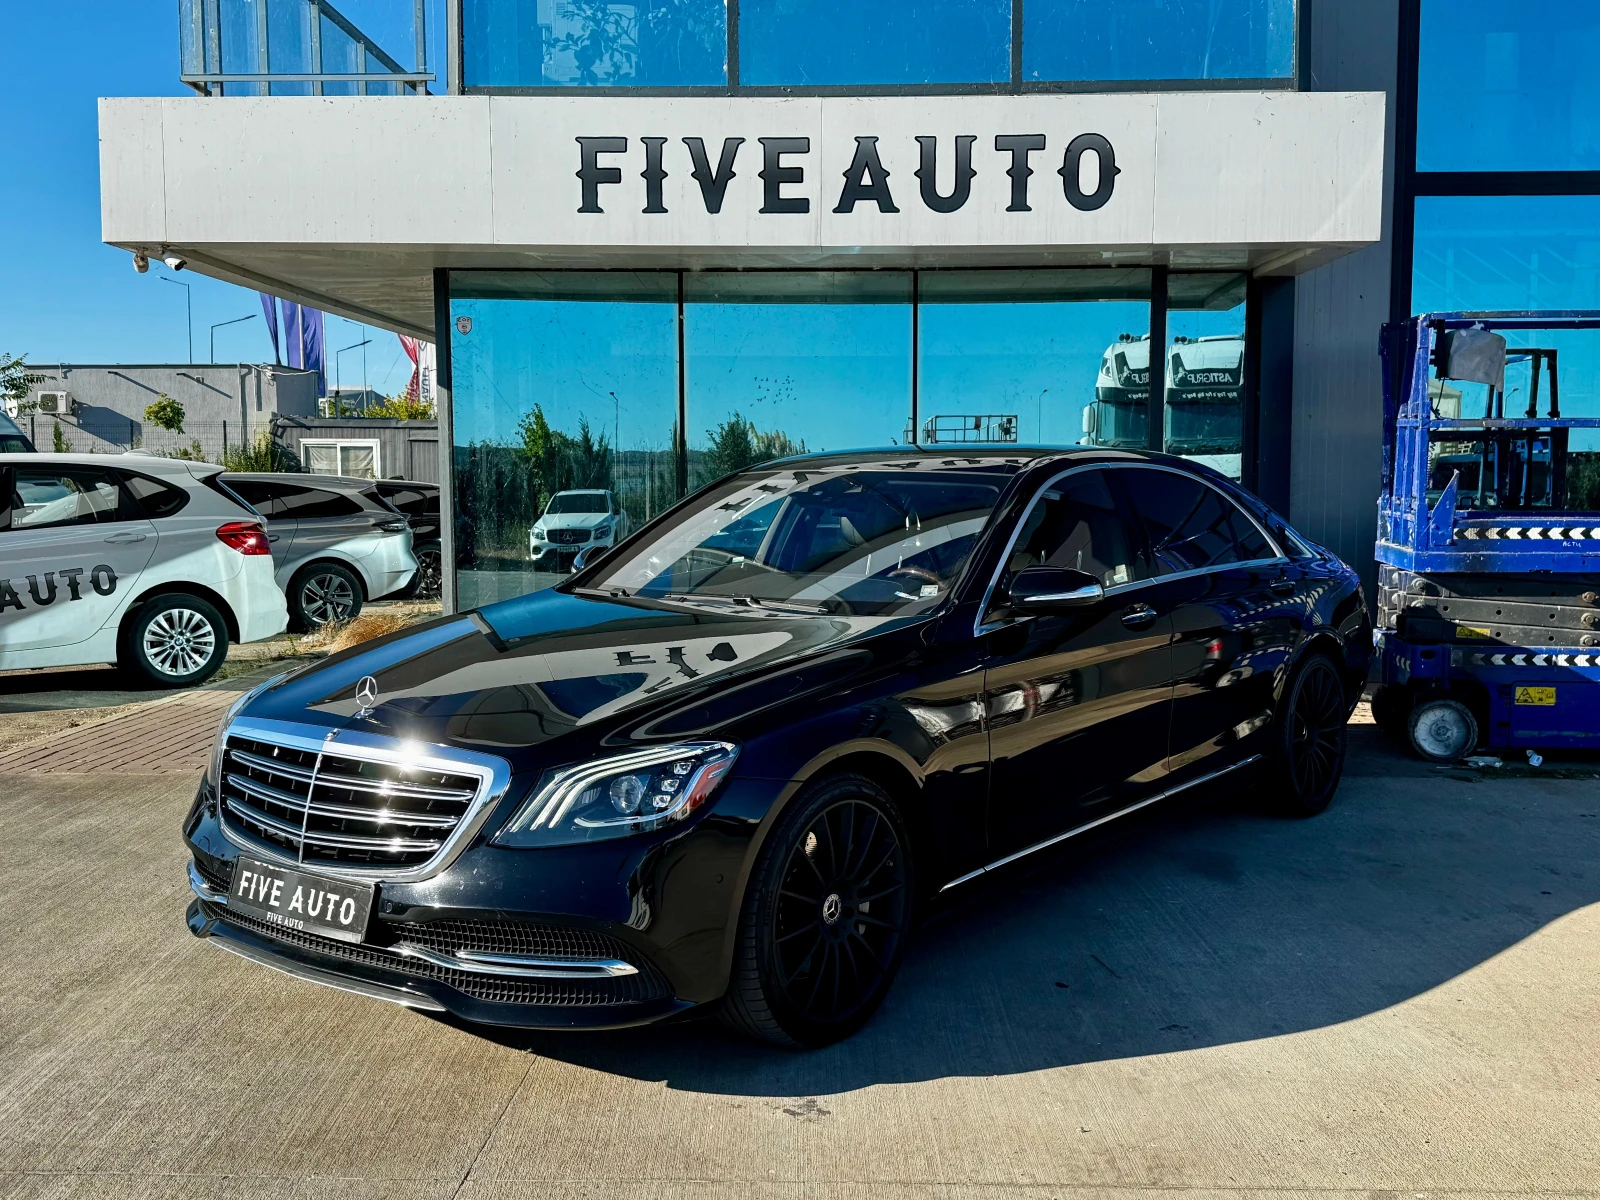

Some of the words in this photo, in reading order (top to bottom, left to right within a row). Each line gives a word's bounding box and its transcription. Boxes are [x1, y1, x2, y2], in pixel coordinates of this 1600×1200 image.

[238, 870, 285, 907] FIVE
[288, 885, 356, 925] AUTO
[266, 911, 283, 924] FIVE
[284, 917, 304, 930] AUTO
